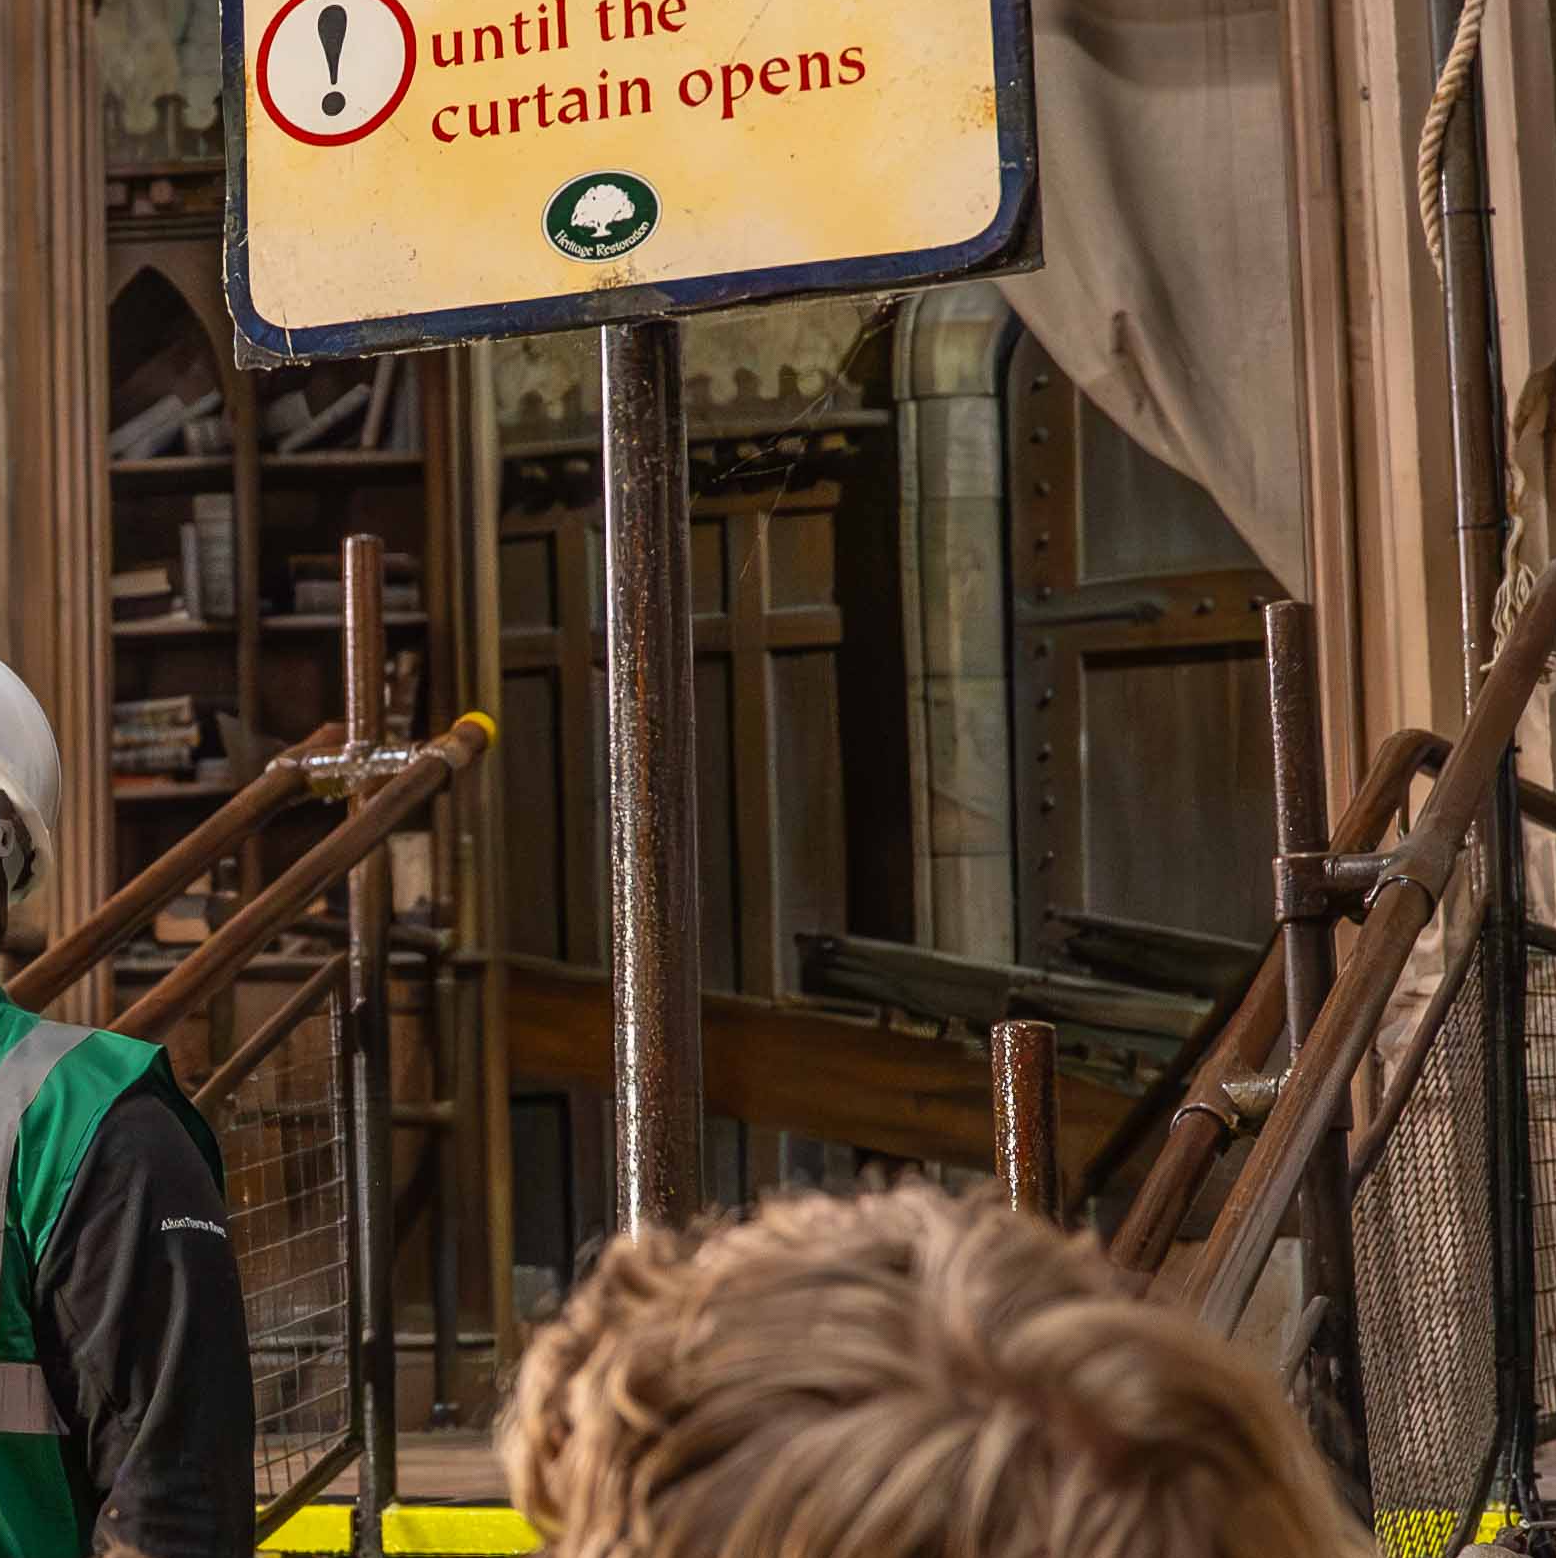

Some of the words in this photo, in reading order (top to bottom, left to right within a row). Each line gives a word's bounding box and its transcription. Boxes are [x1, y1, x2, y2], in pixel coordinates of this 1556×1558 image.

[431, 69, 653, 144] curtain
[678, 45, 867, 120] opens
[554, 229, 594, 257] Heritage
[596, 221, 650, 257] Restoration
